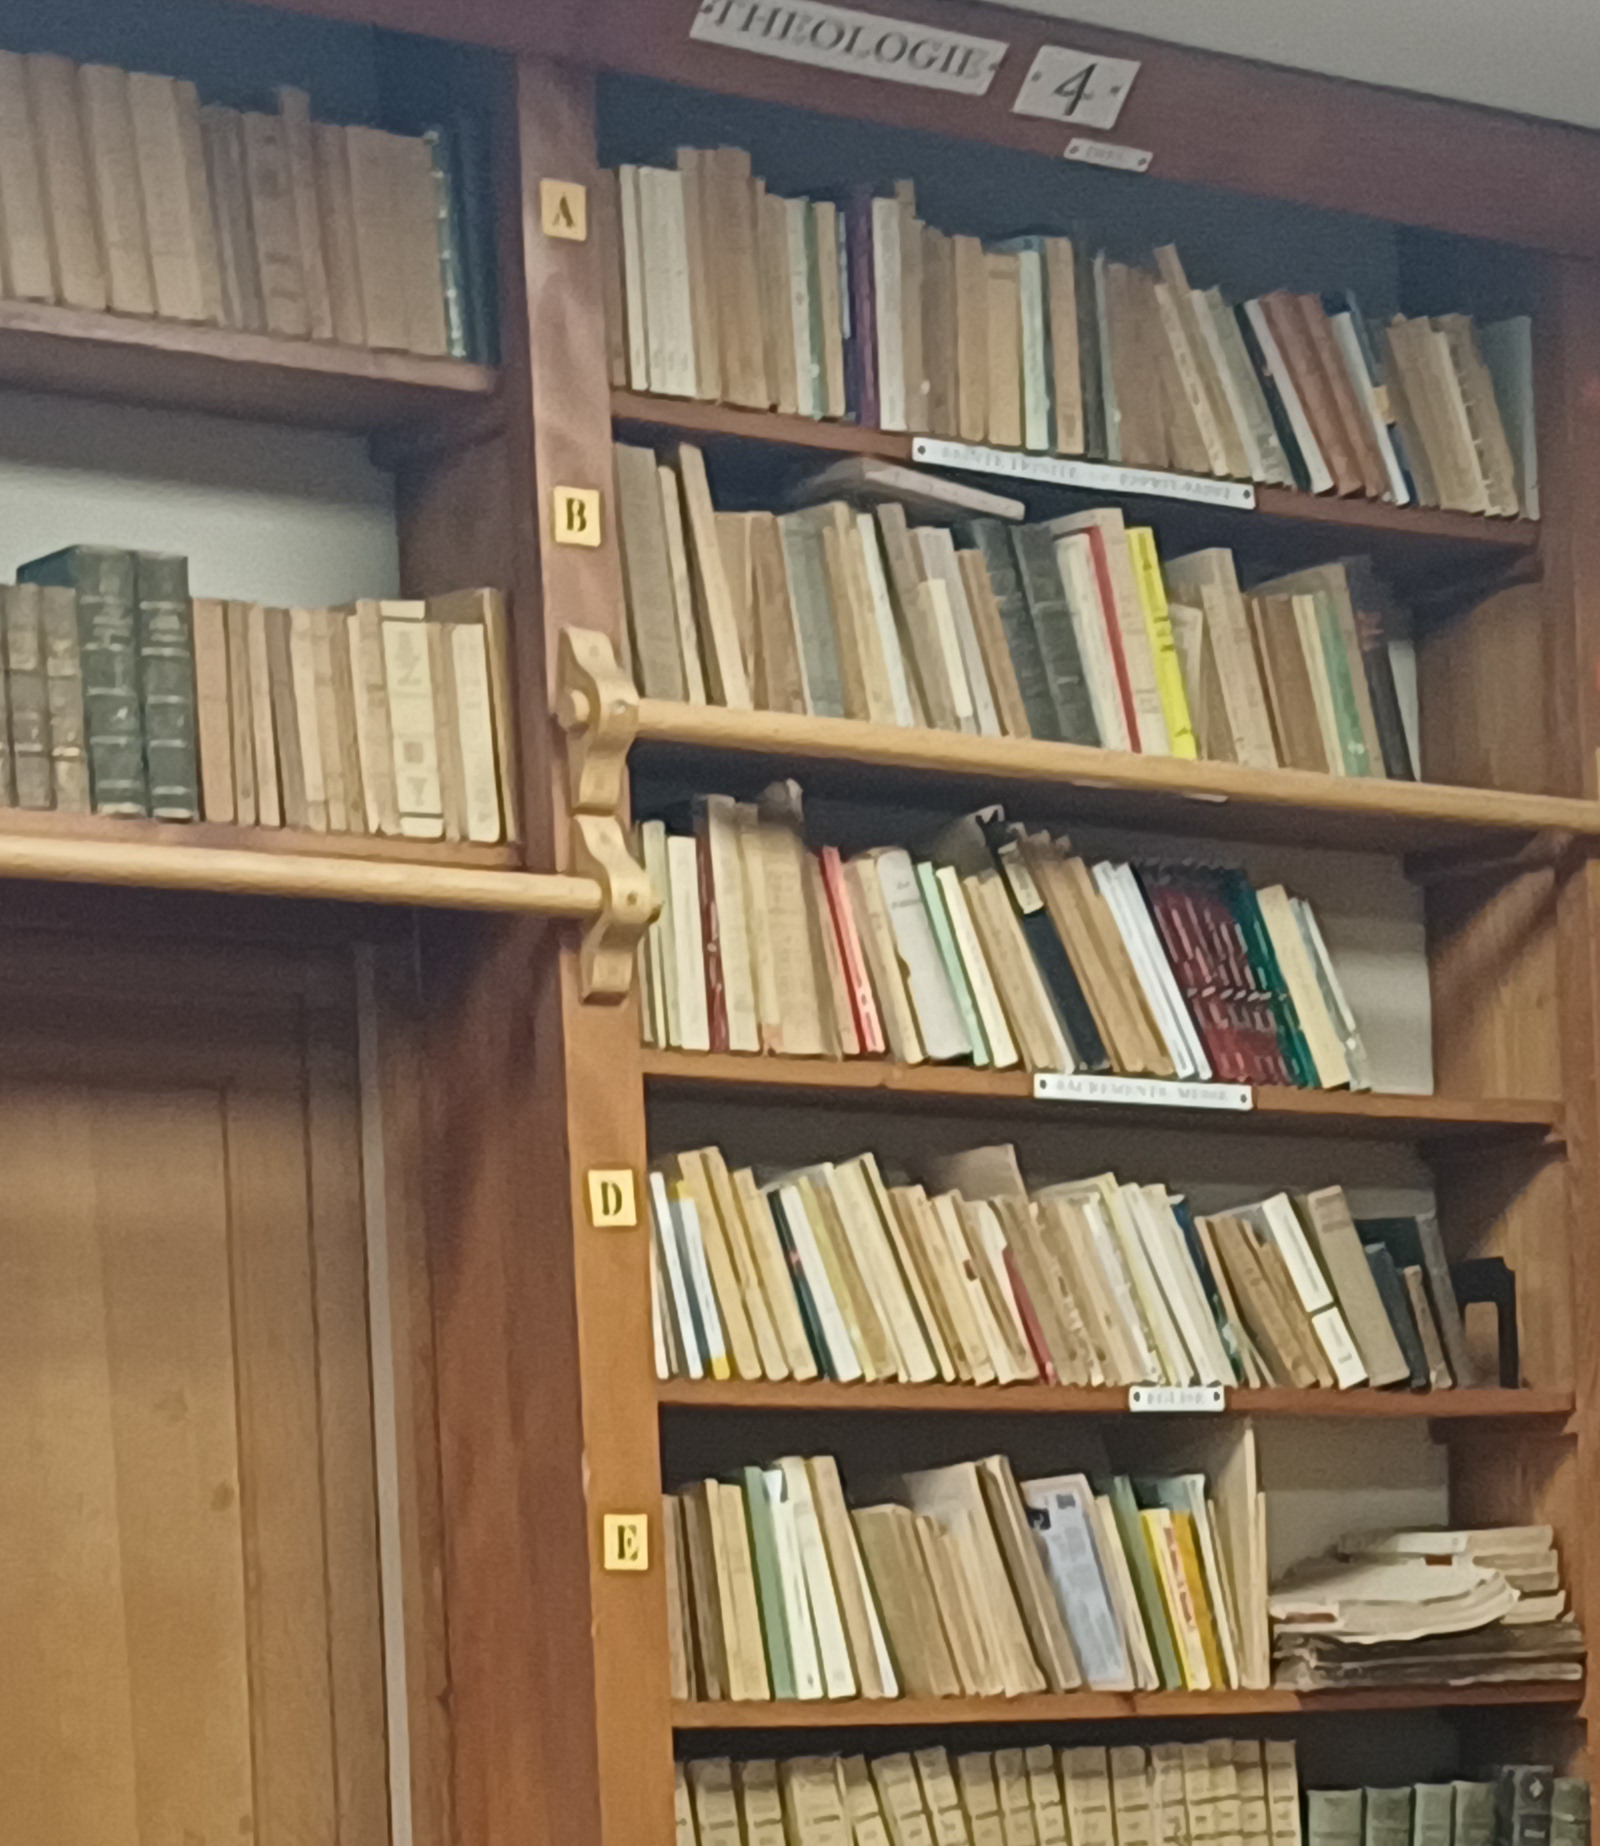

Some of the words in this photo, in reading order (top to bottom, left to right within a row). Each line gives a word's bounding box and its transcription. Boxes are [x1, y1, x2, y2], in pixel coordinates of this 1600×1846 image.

[1052, 62, 1099, 117] 4
[551, 191, 577, 229] A
[563, 496, 588, 533] B
[599, 1180, 624, 1217] D
[615, 1523, 639, 1562] E
